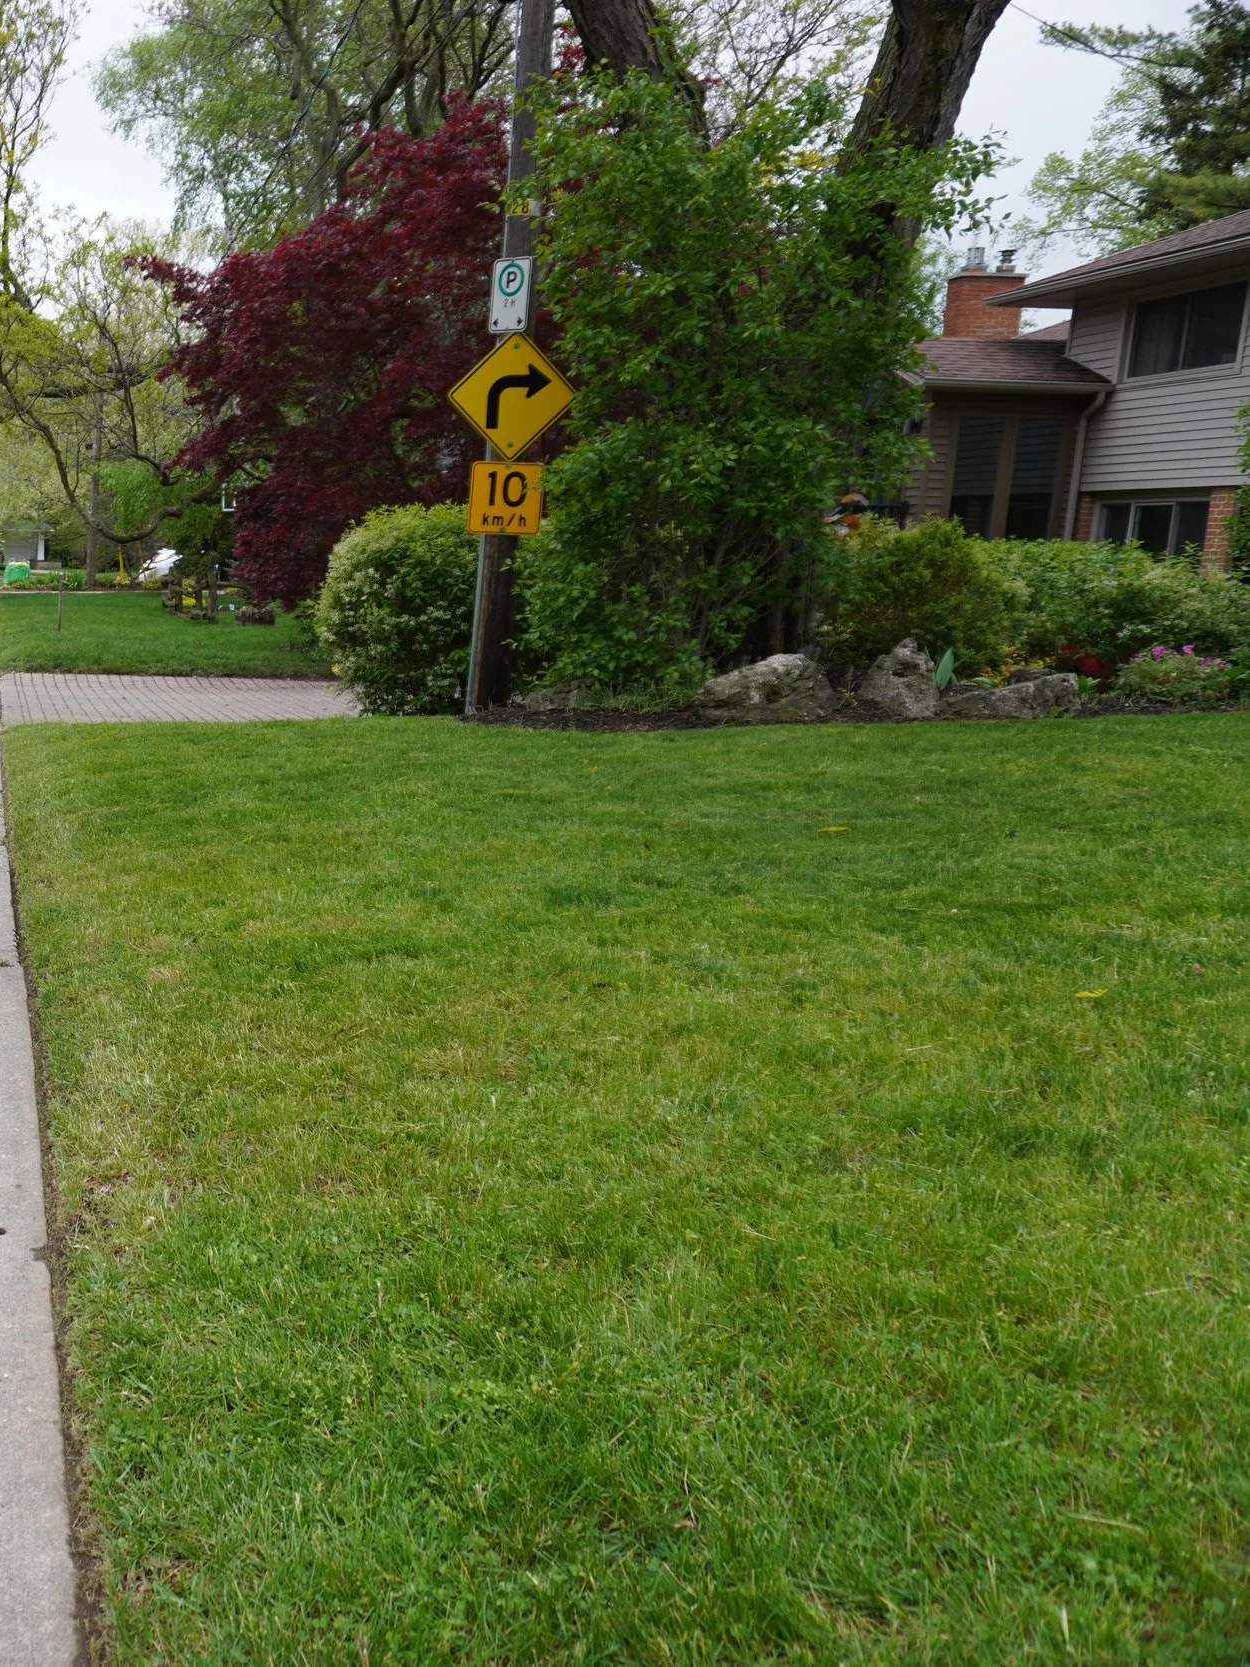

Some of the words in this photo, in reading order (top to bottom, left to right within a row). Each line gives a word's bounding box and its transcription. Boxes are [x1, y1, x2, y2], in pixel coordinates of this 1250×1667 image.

[506, 271, 517, 288] P
[489, 471, 527, 507] 10
[482, 513, 526, 527] km/h
